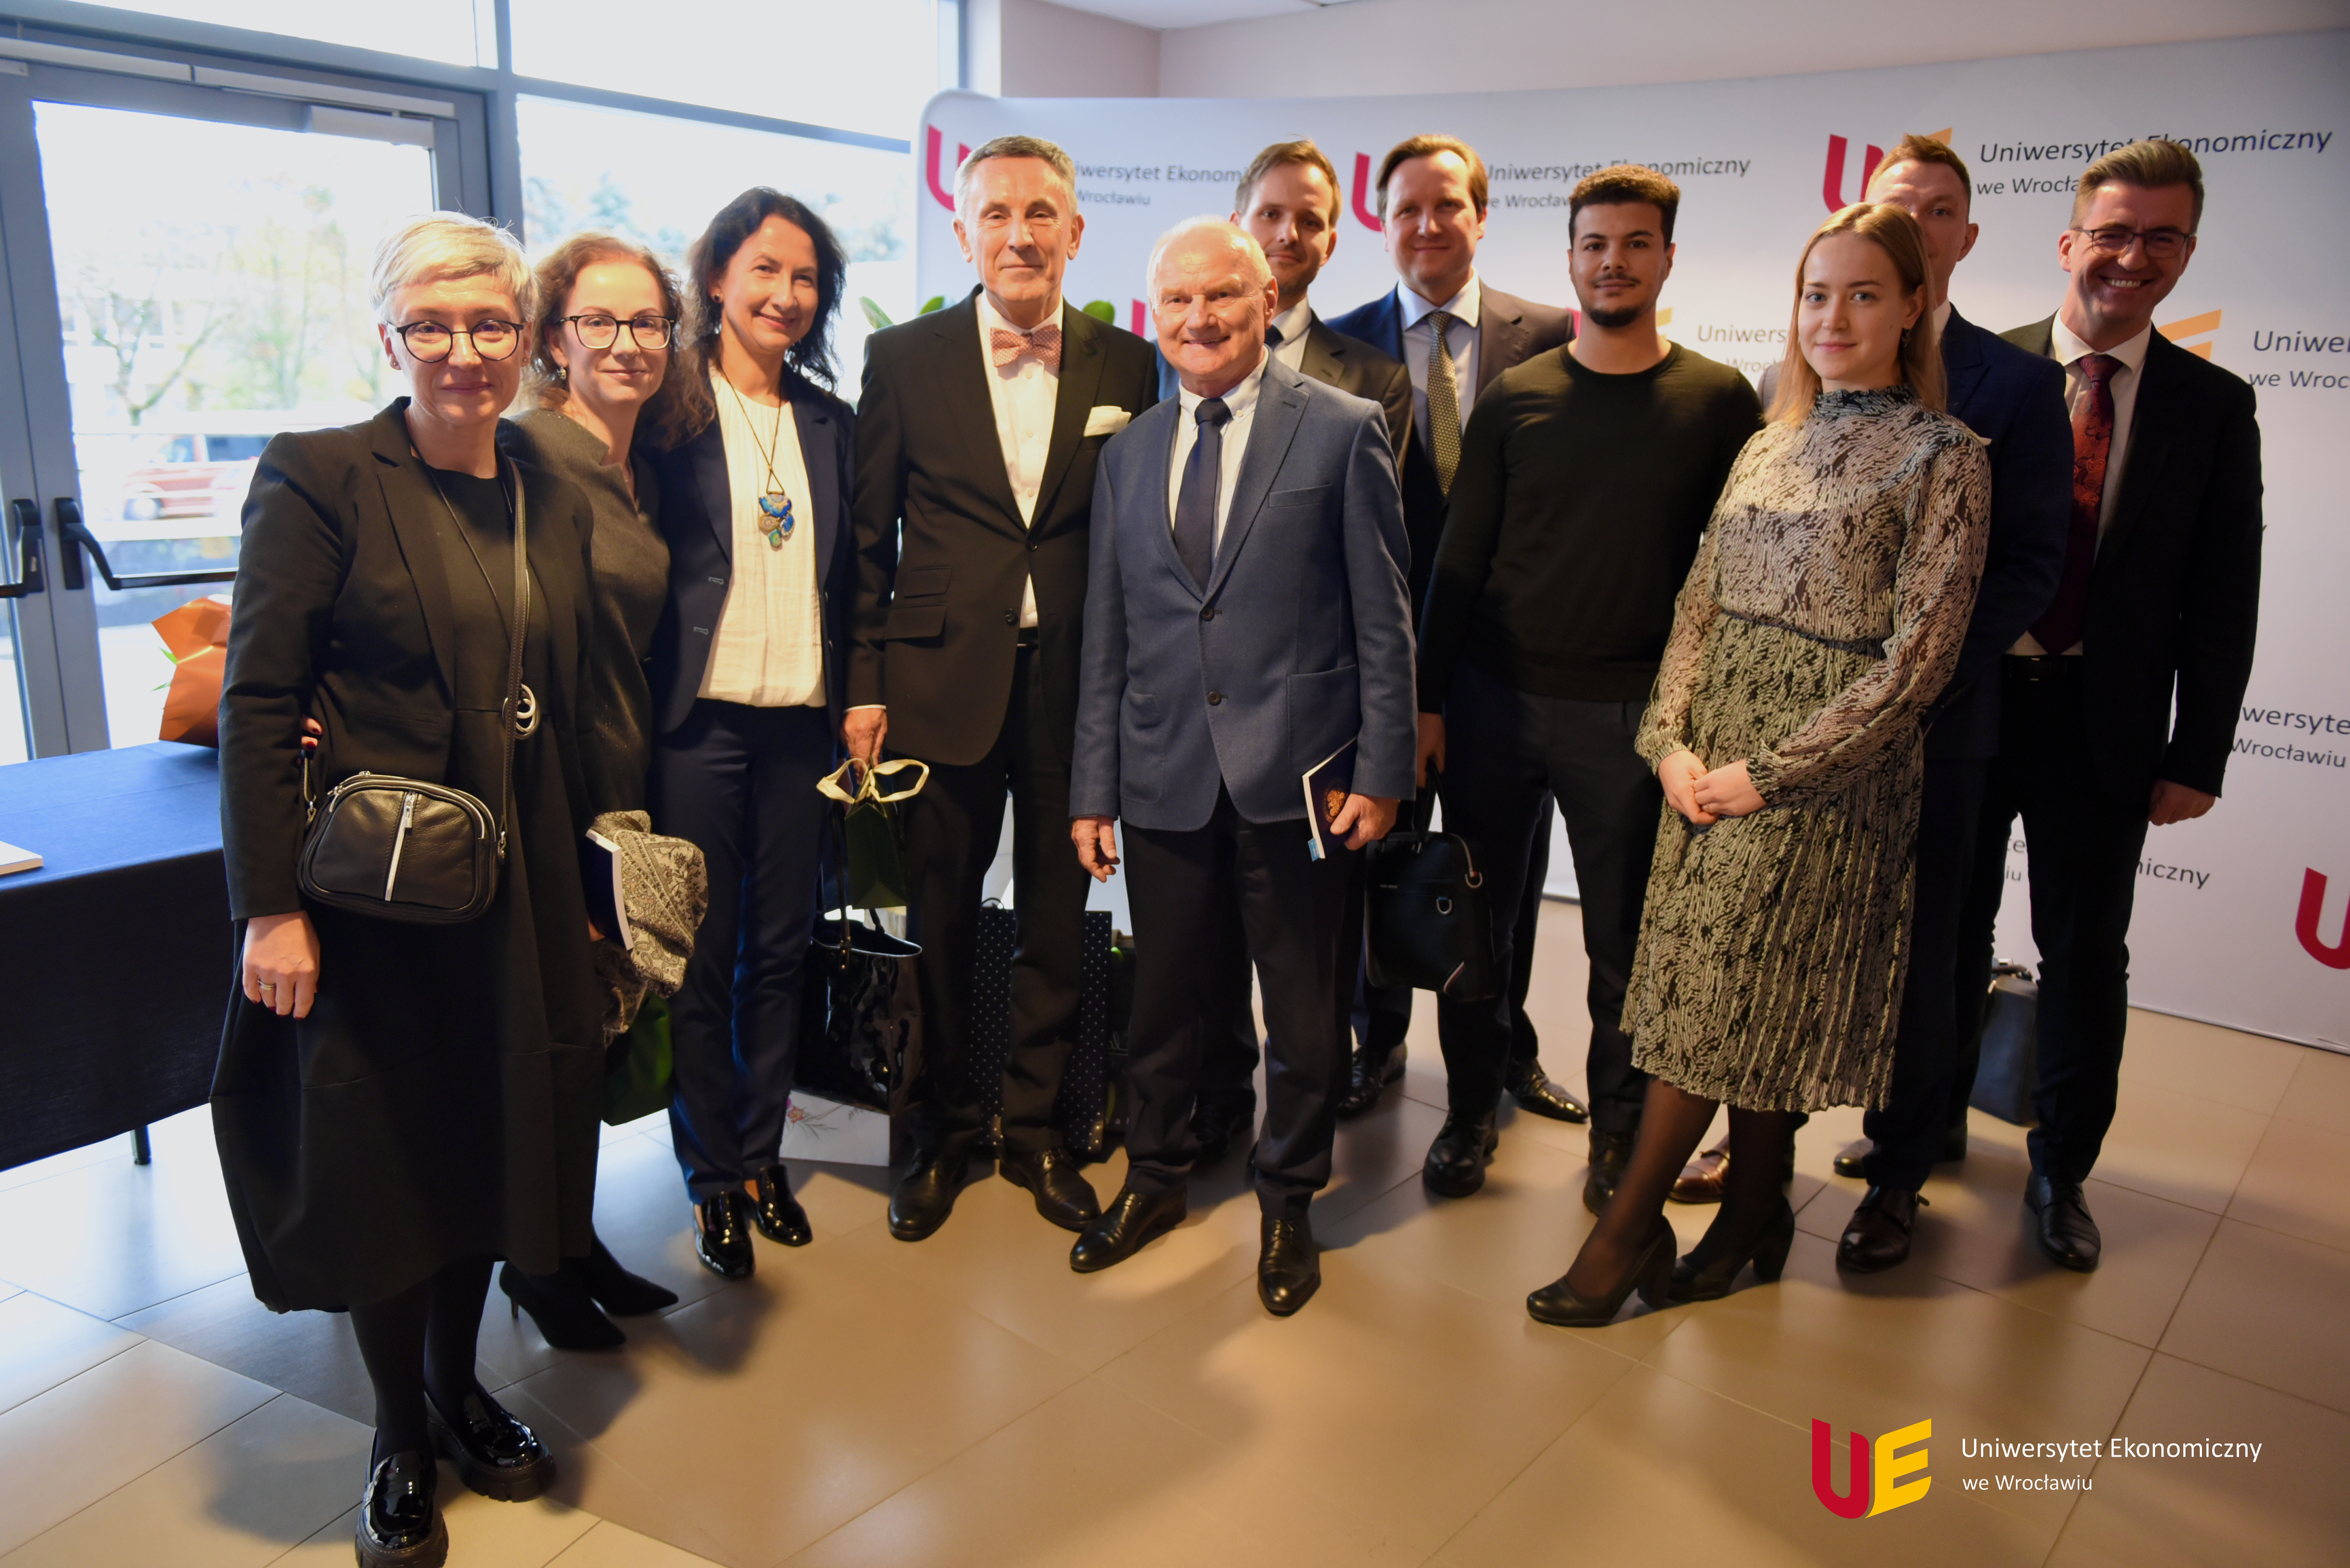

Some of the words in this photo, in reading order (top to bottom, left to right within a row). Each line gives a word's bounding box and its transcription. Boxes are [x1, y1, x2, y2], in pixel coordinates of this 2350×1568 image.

[2147, 129, 2332, 153] onomiczny
[1166, 164, 1248, 183] Ekonom
[1977, 182, 2004, 194] we
[1698, 324, 1789, 343] Uniwers
[2249, 373, 2281, 387] we
